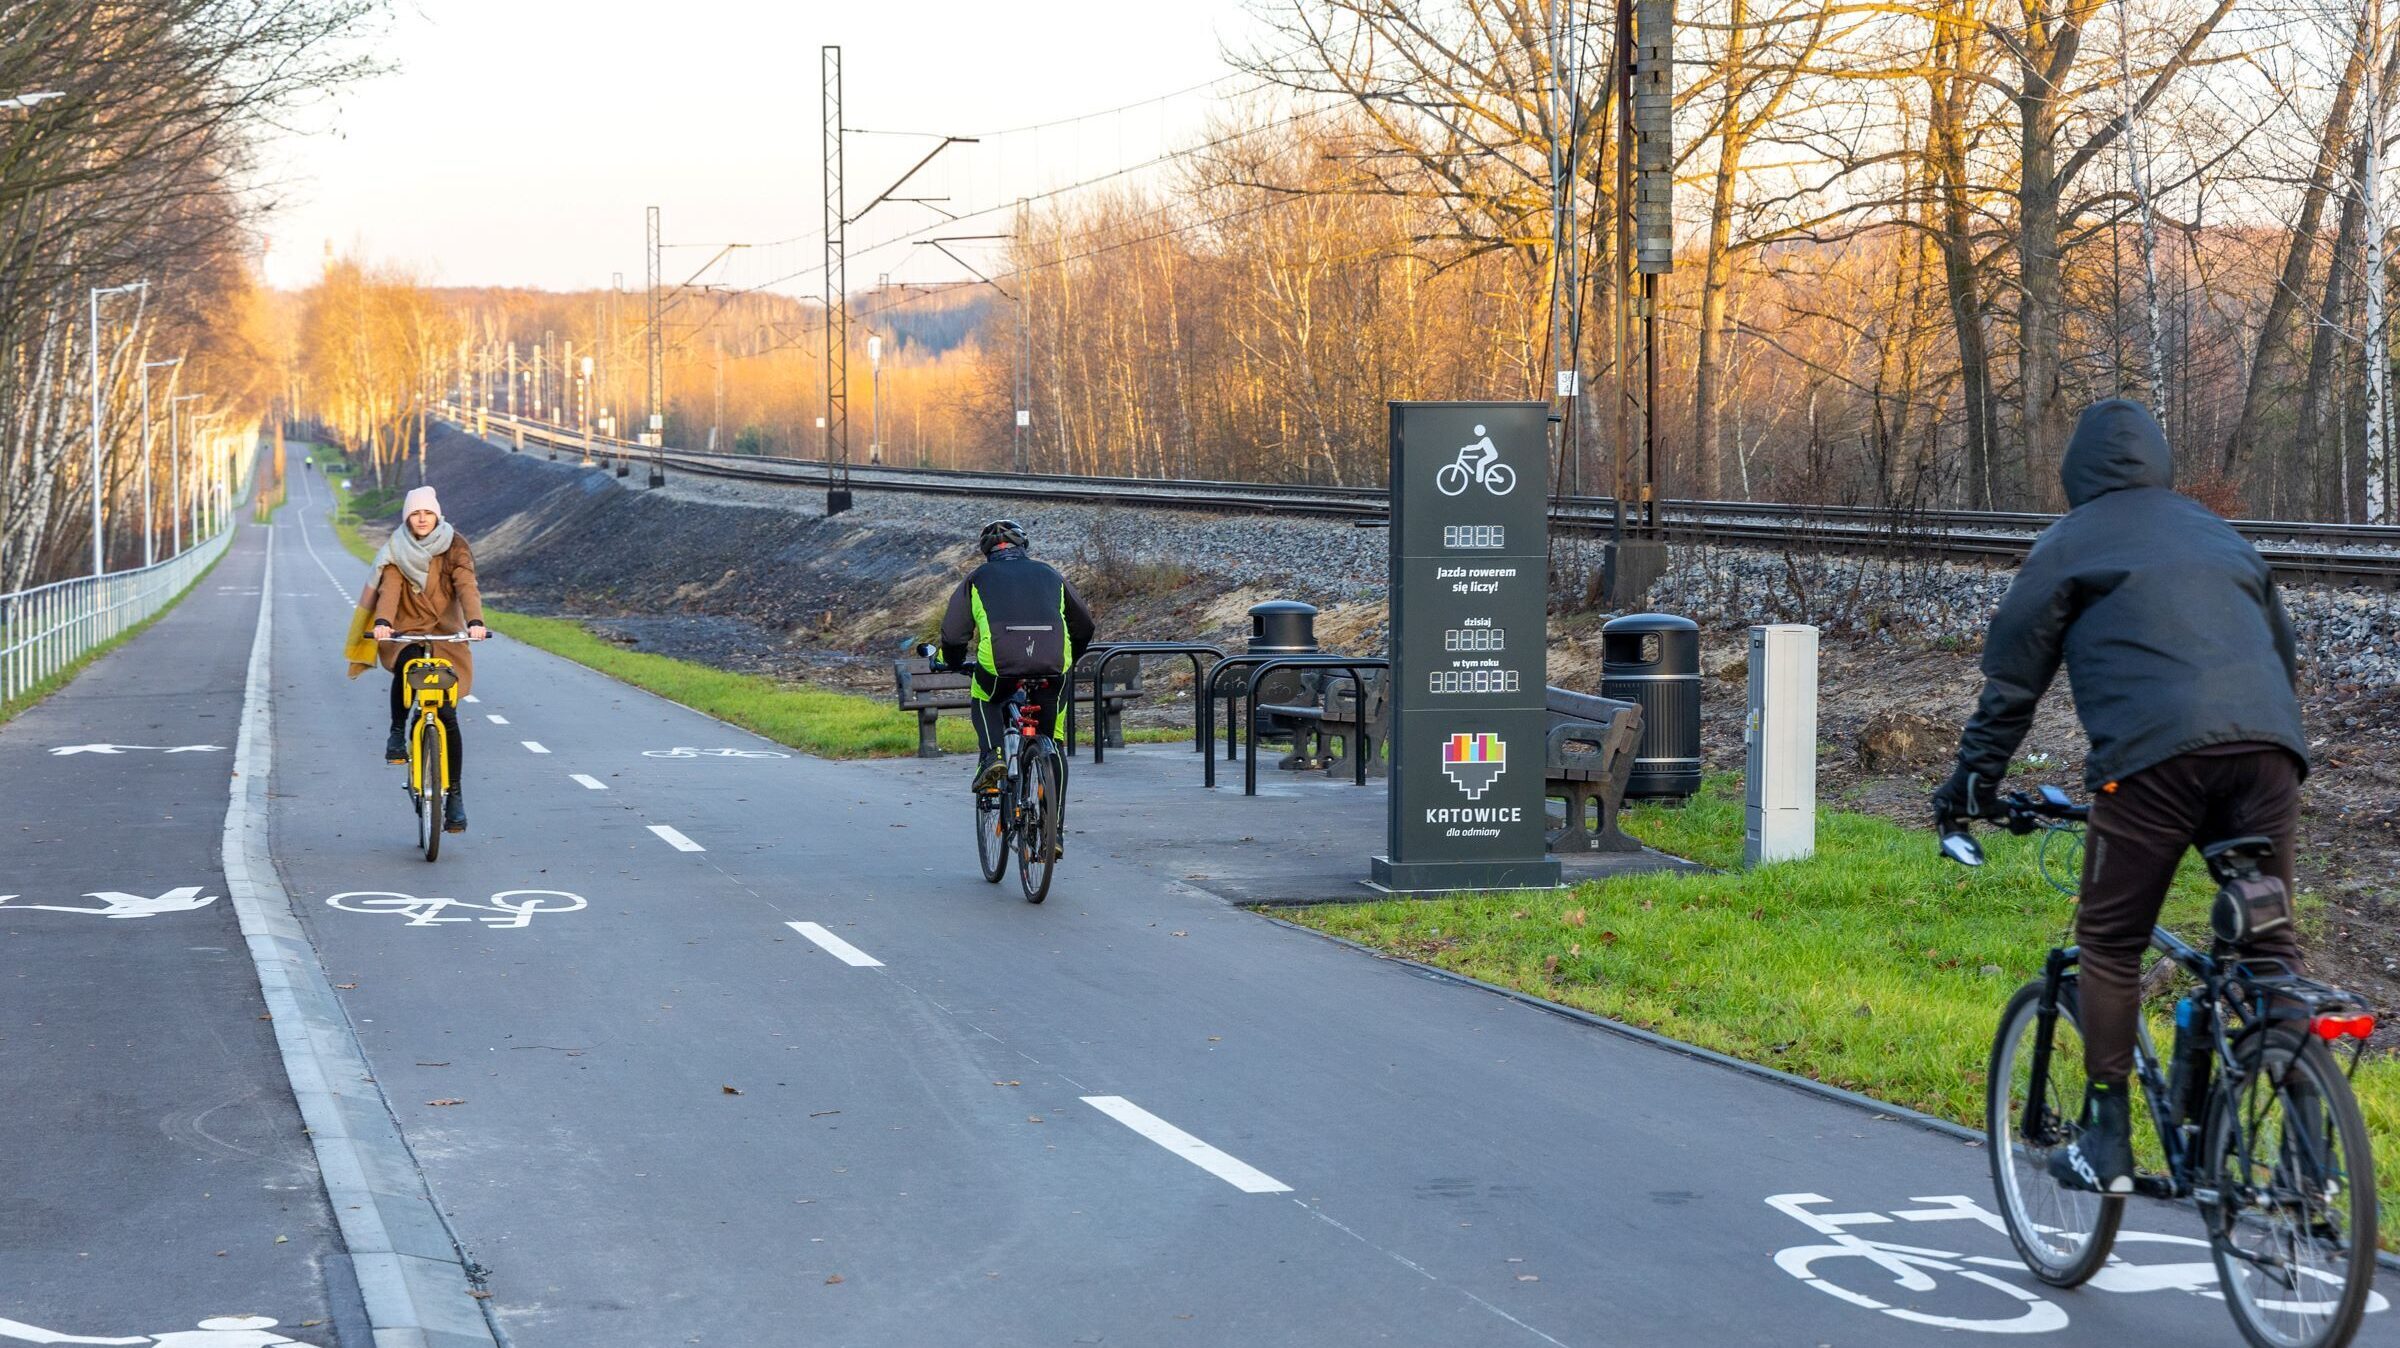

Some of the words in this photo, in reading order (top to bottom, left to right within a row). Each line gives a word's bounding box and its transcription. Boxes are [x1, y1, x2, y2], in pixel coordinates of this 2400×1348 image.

[1436, 566, 1467, 580] Jazda
[1468, 568, 1517, 578] rowerem
[1452, 581, 1469, 595] się
[1470, 581, 1499, 595] liczy!
[1464, 617, 1492, 628] dzisiaj
[1452, 660, 1461, 668] w
[1462, 659, 1478, 669] tym
[1479, 659, 1500, 668] roku
[1426, 807, 1522, 823] KATOWICE
[1446, 827, 1461, 837] dla
[1461, 827, 1501, 838] odmiany
